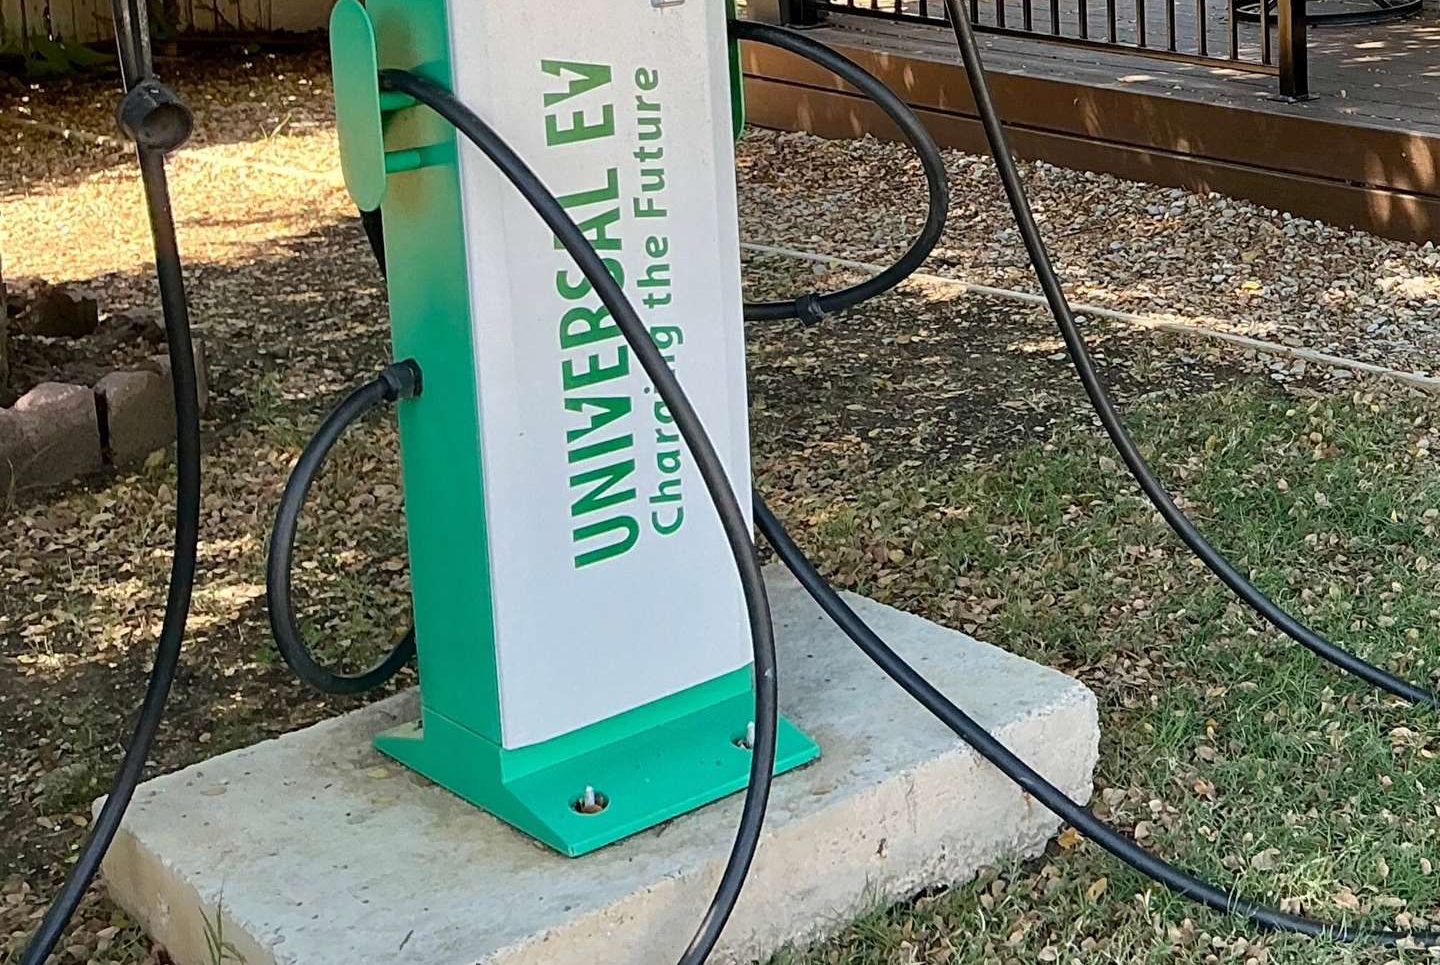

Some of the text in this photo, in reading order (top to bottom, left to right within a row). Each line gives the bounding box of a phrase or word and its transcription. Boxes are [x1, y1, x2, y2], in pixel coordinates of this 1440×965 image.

[541, 59, 640, 569] UNIVERSAL EV
[633, 67, 685, 535] Charg the Future
